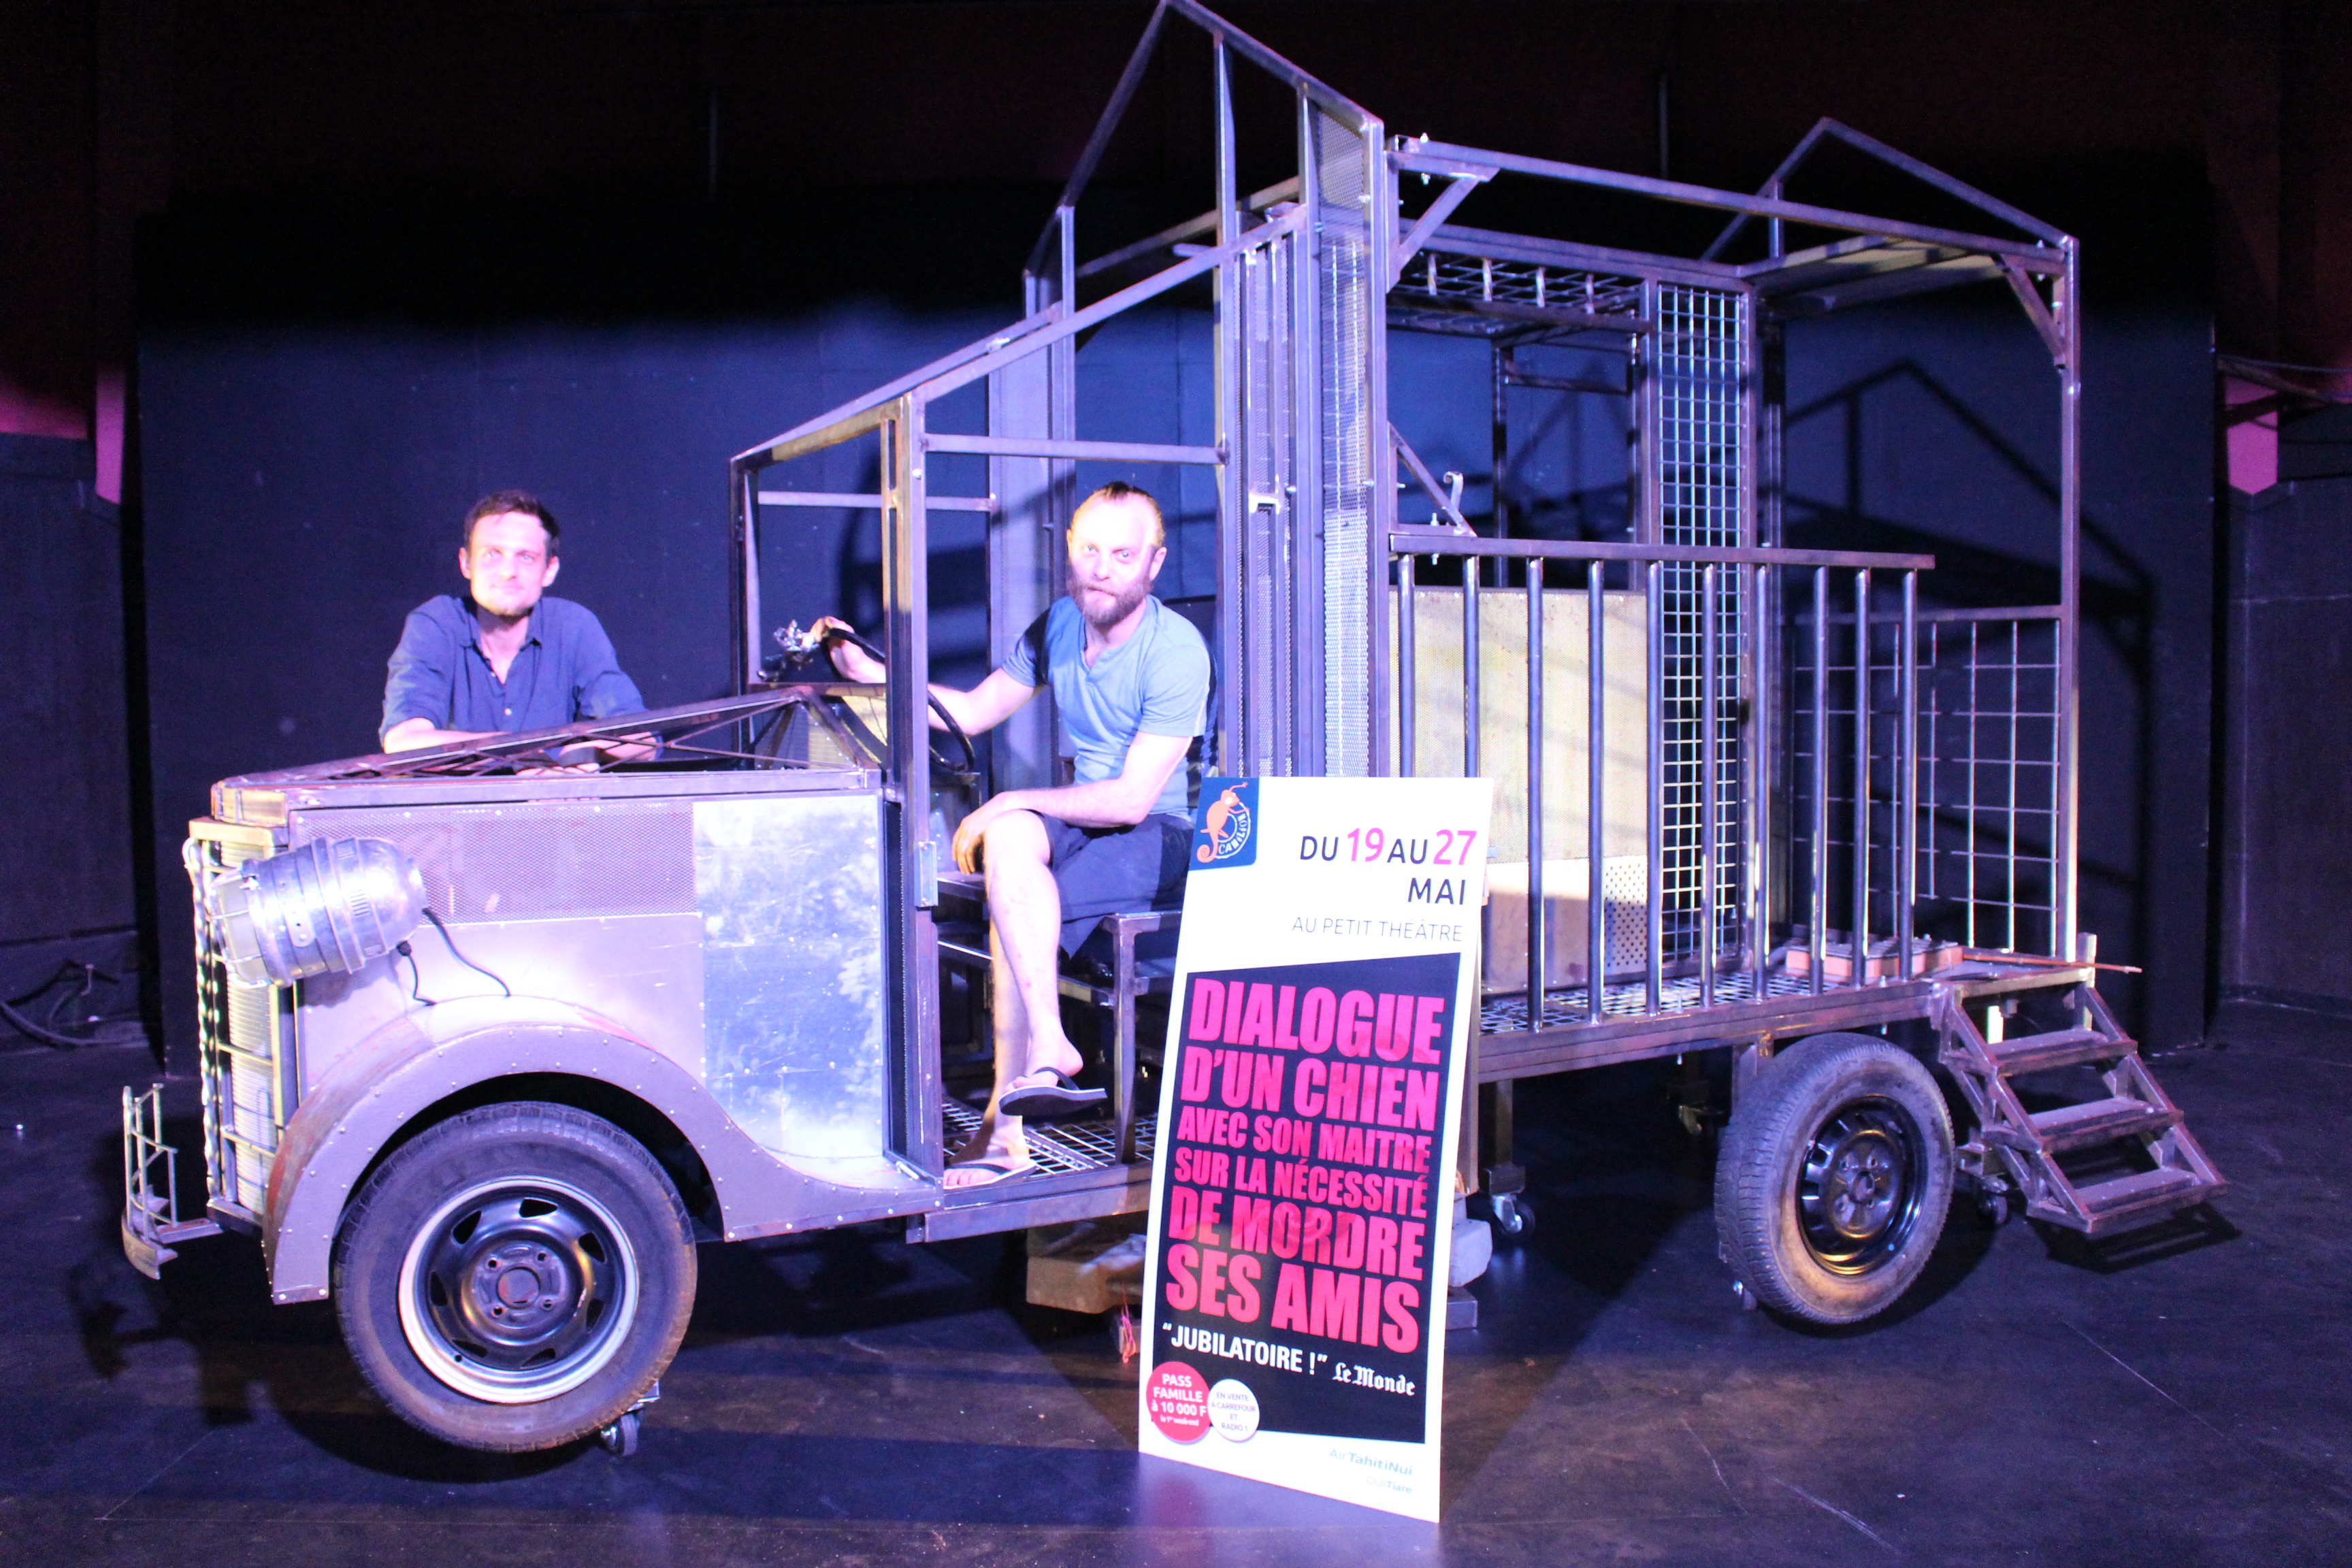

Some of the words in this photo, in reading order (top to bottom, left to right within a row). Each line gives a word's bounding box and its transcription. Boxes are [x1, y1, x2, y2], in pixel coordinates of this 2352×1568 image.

[1300, 836, 1339, 862] DU
[1347, 828, 1385, 862] 19
[1387, 838, 1428, 864] AU
[1433, 829, 1477, 866] 27
[1407, 877, 1466, 905] MAI
[1292, 916, 1318, 933] AU
[1323, 917, 1373, 937] PETIT
[1380, 917, 1463, 943] THÉÂTRE
[1188, 978, 1445, 1065] DIALOGUE
[1293, 1058, 1440, 1132] CHIEN
[1176, 1105, 1249, 1149] AVEC
[1253, 1117, 1312, 1158] SON
[1318, 1122, 1432, 1174] MAITRE
[1174, 1146, 1230, 1188] SUR
[1235, 1155, 1267, 1195] LA
[1273, 1158, 1428, 1219] NÉCESSITÉ
[1168, 1185, 1223, 1246] DE
[1230, 1194, 1426, 1281] MORDRE
[1165, 1243, 1262, 1323] SES
[1270, 1264, 1420, 1354] AMIS
[1153, 1386, 1204, 1403] FAMILLE
[1162, 1373, 1192, 1388] PASS
[1331, 1362, 1352, 1384] Le
[1353, 1365, 1416, 1396] Monde
[1151, 1399, 1159, 1412] à
[1160, 1401, 1175, 1414] 10
[1176, 1403, 1198, 1416] 000
[1199, 1405, 1207, 1417] F
[1216, 1402, 1256, 1413] CARREFOUR
[1226, 1392, 1250, 1402] VENTE
[1221, 1422, 1243, 1432] RADIO
